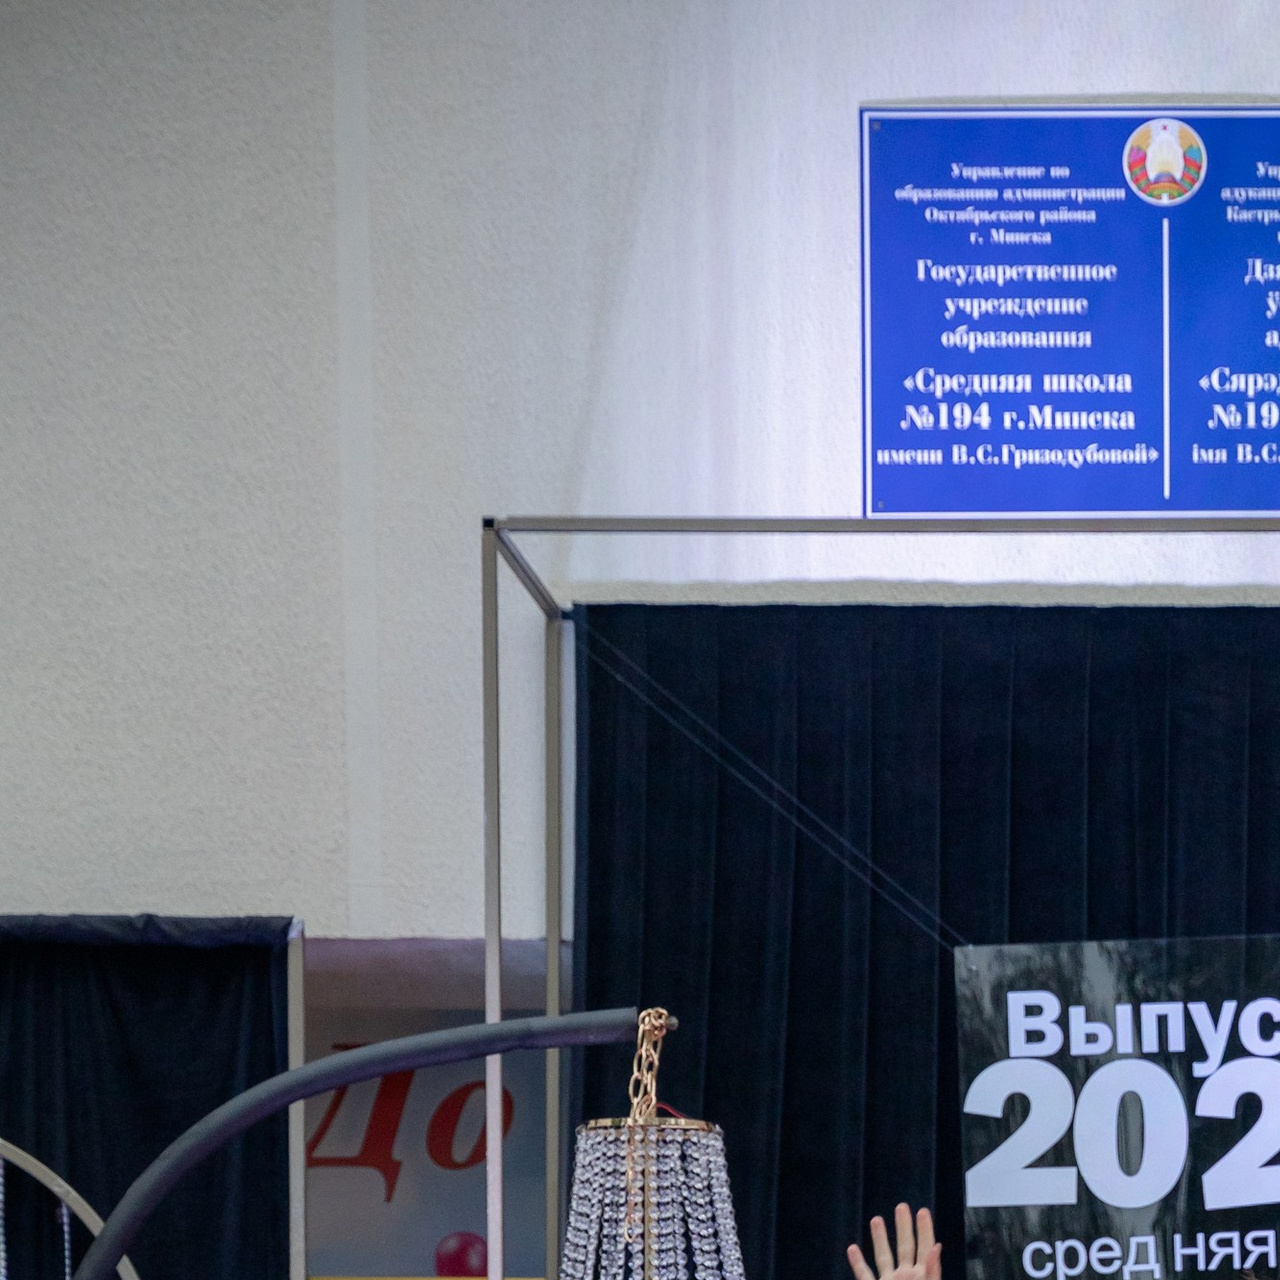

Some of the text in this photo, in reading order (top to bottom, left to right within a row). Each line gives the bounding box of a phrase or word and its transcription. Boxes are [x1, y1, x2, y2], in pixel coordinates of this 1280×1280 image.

[951, 162, 1070, 183] Управление по
[894, 184, 1126, 205] образованию администрации
[924, 206, 1096, 226] Октябрьского района
[969, 228, 1052, 245] г. Минска
[916, 259, 1118, 287] Государственное
[944, 298, 1089, 321] учреждение
[940, 324, 1092, 354] образования
[902, 367, 1133, 399] «Средняя школа
[900, 401, 1136, 431] №194 г.Минска
[876, 449, 943, 465] имени
[1191, 443, 1228, 464] імя
